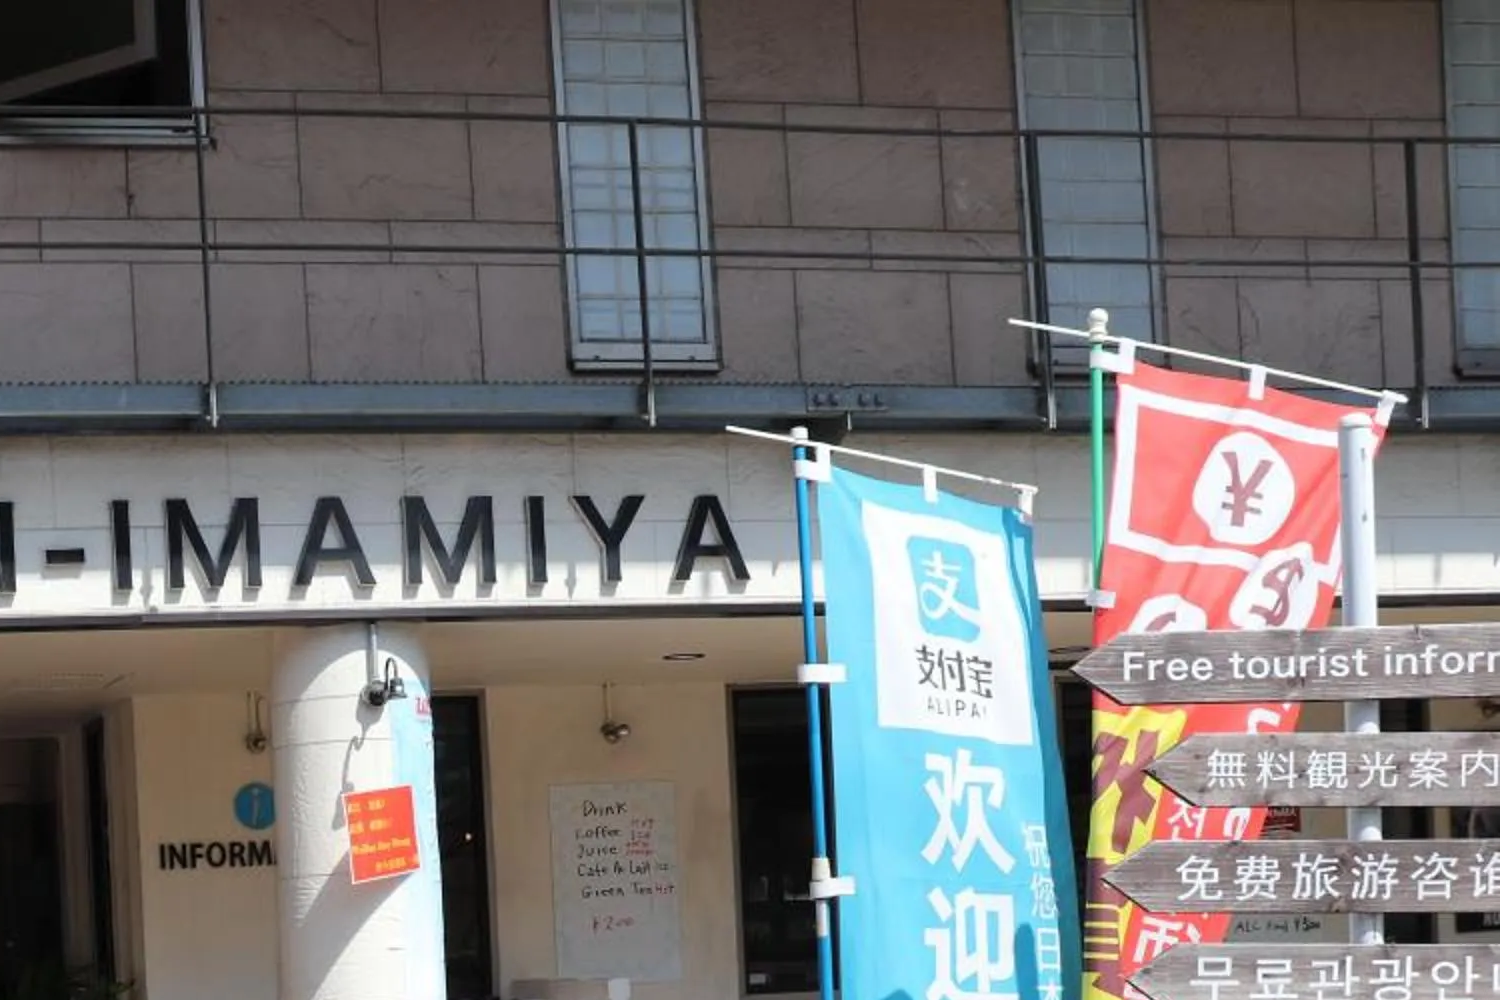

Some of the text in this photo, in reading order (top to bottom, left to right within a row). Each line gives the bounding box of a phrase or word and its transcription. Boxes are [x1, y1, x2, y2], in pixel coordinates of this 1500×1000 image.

[915, 644, 993, 699] 支付宝
[1122, 651, 1213, 681] Free
[1228, 647, 1369, 680] tourist
[1206, 747, 1499, 790] 無料観光案内
[582, 799, 628, 817] Drink
[158, 839, 278, 871] INFORM
